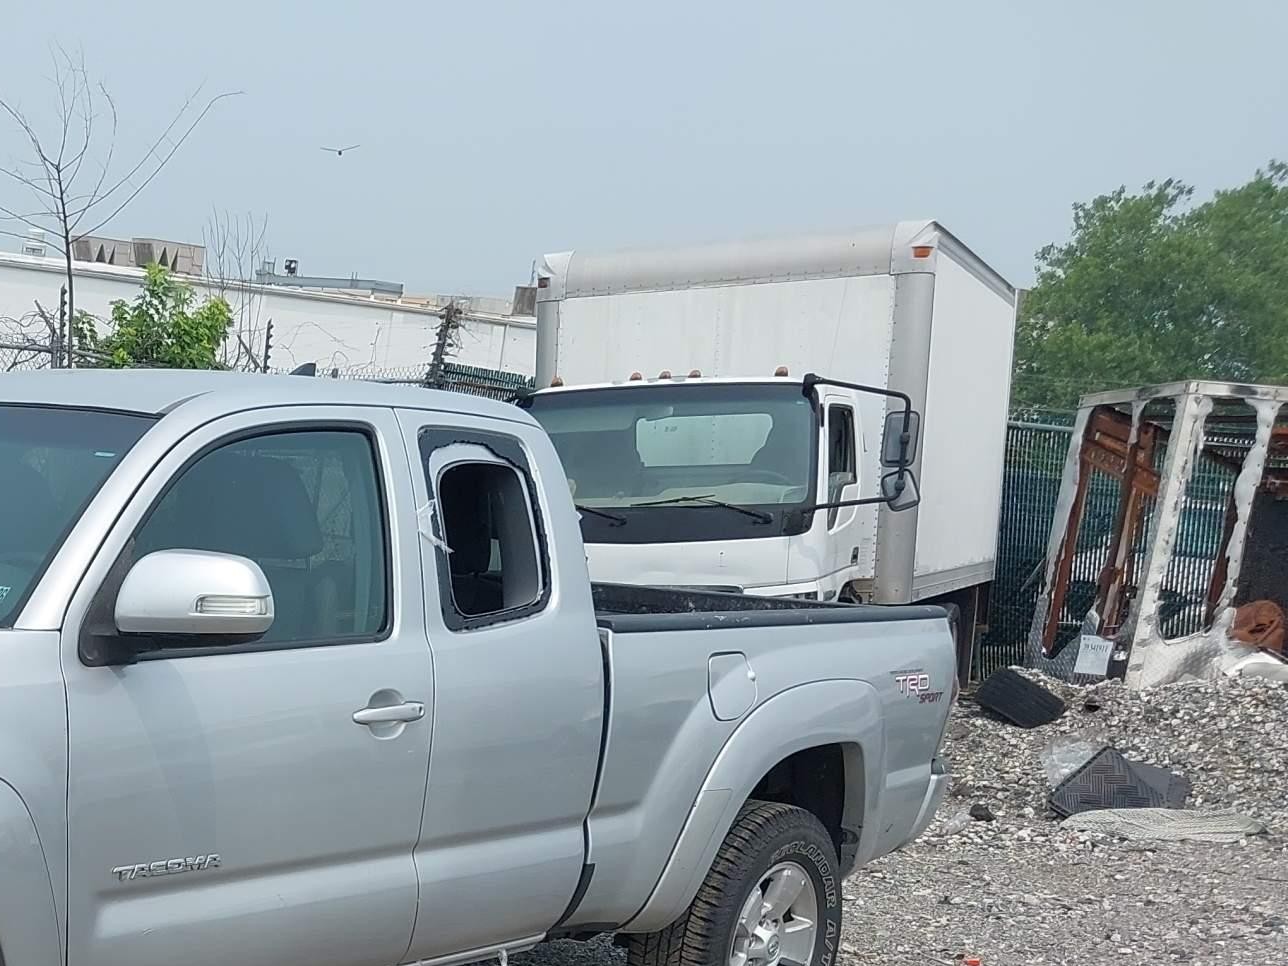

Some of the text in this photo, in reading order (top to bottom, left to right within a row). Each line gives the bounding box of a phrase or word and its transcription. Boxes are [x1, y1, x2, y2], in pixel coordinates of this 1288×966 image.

[895, 674, 931, 698] TRD
[918, 691, 944, 704] SPORT
[112, 853, 222, 882] TACOMA
